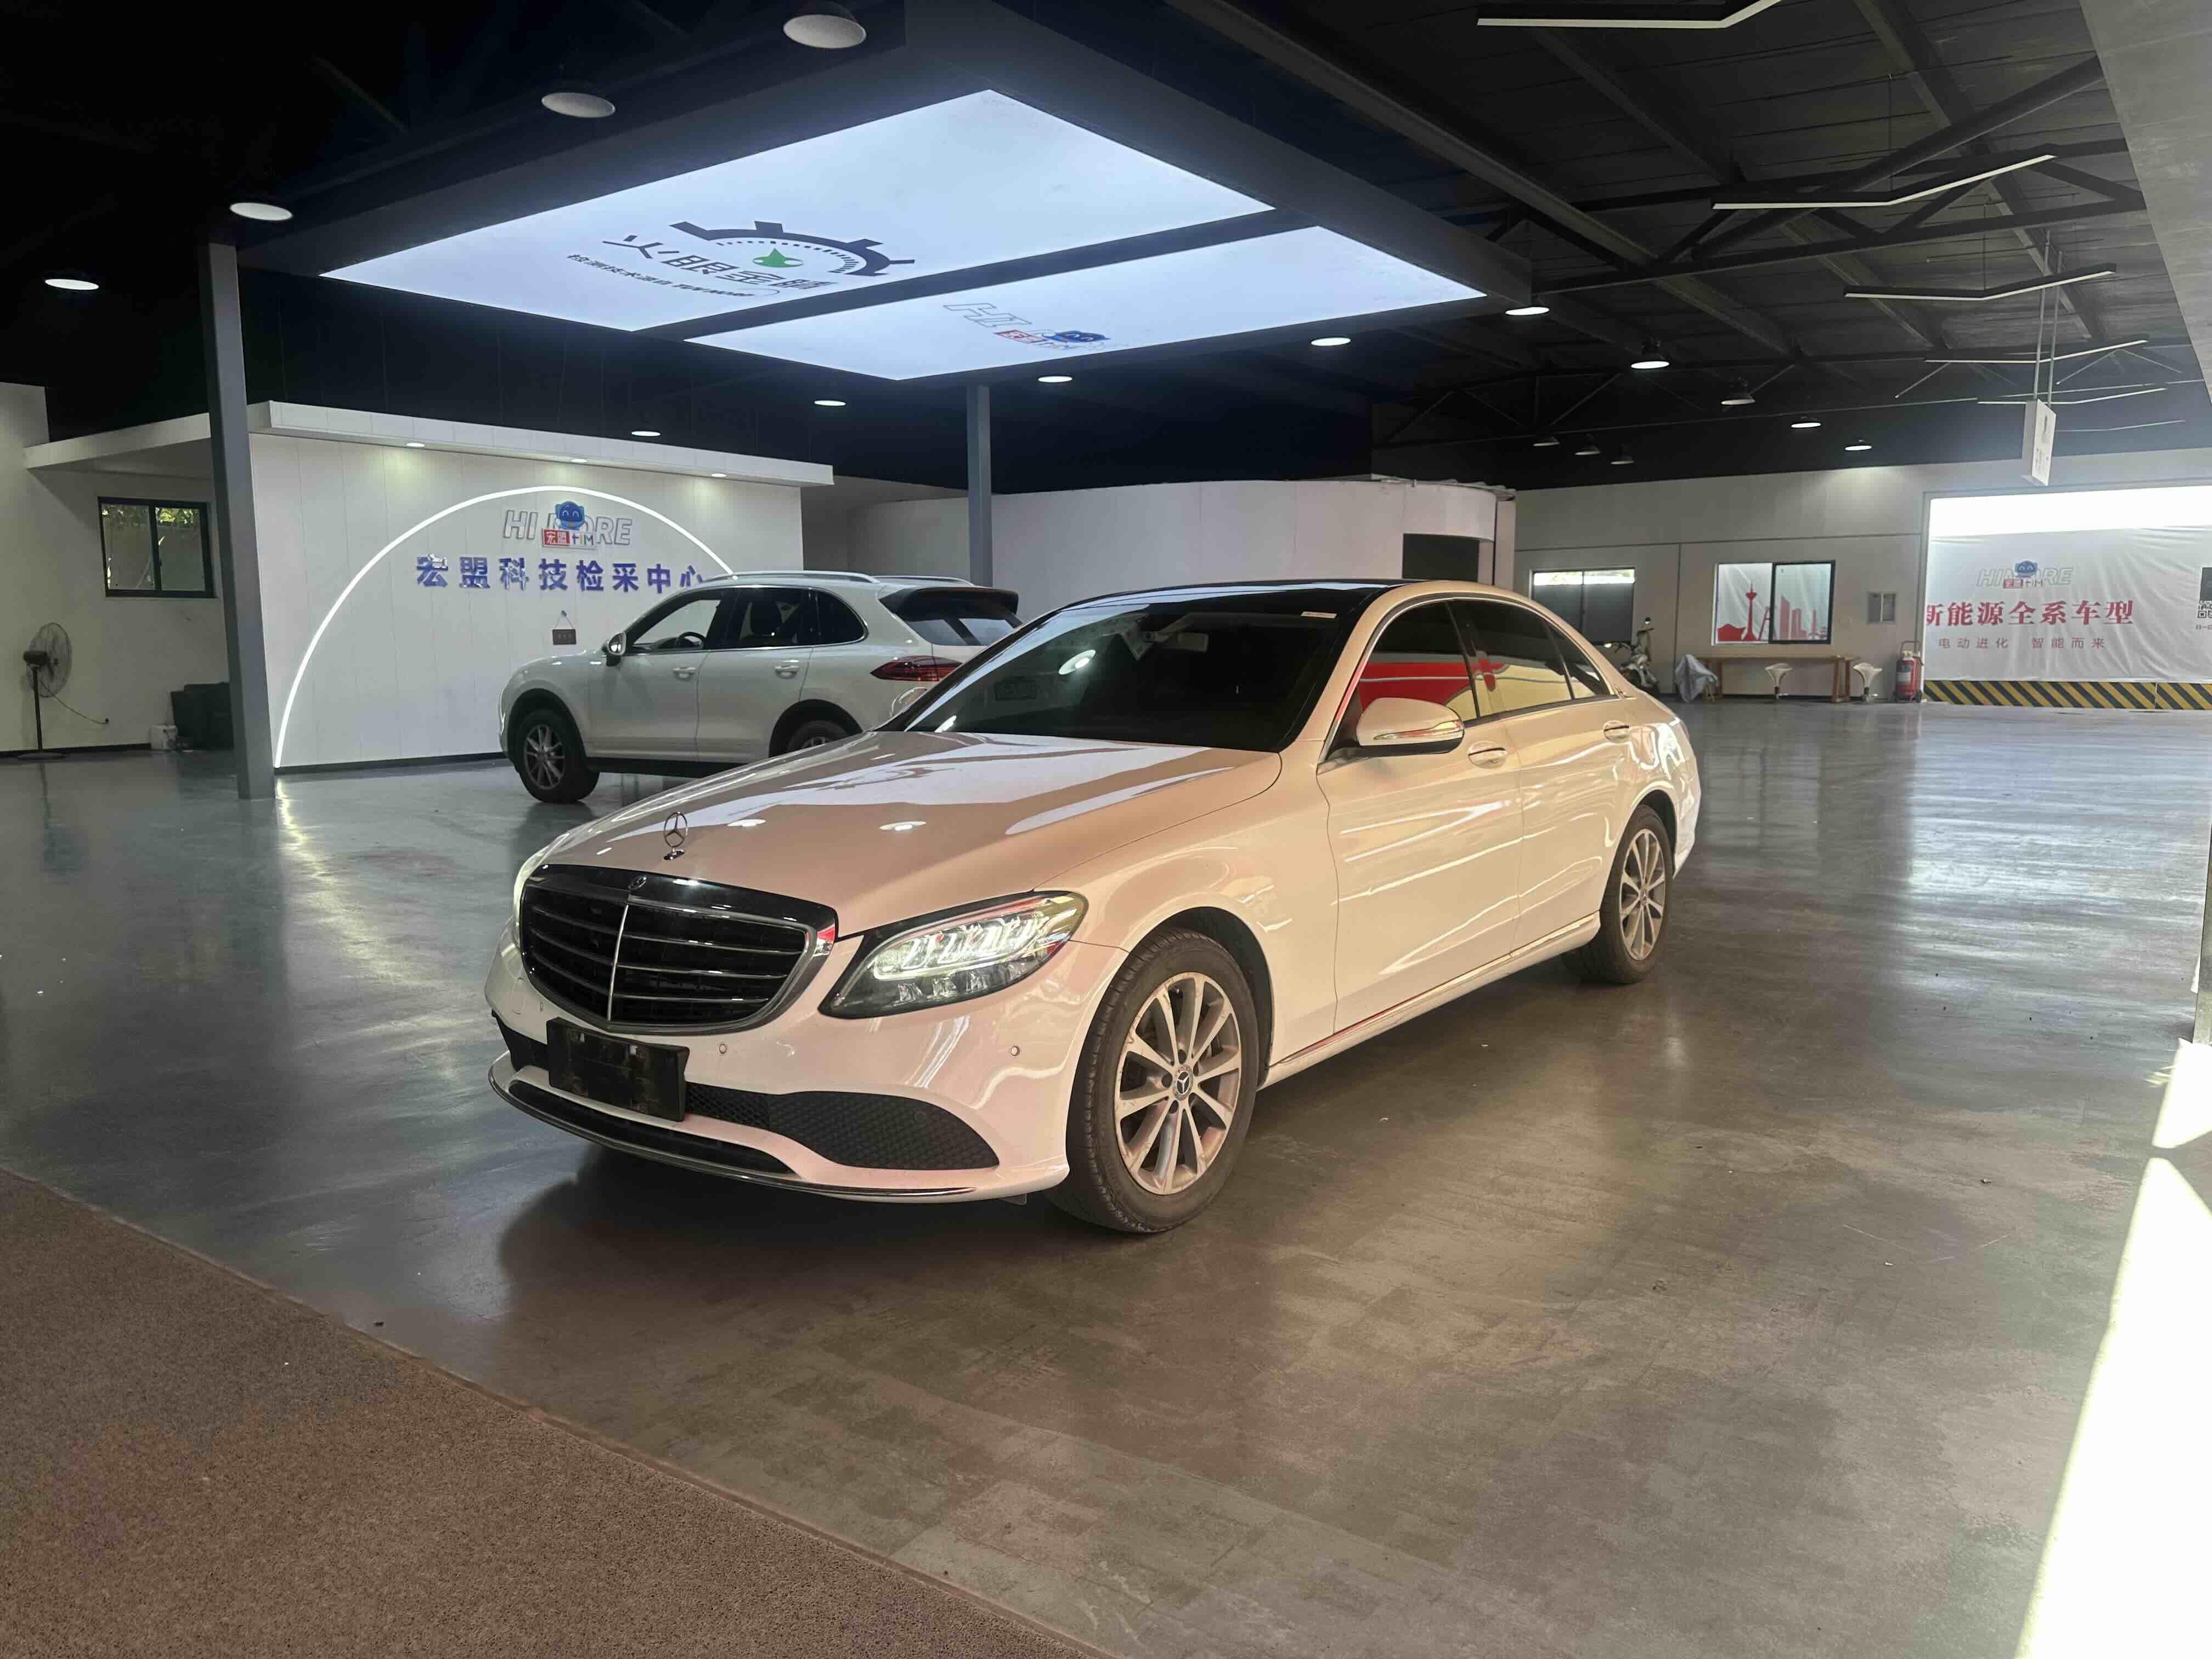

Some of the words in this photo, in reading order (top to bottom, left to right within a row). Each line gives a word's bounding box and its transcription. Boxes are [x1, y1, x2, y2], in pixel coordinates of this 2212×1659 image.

[416, 553, 703, 594] 宏盟科技检采中心
[1926, 600, 2134, 627] 新能源全系车型
[1938, 637, 2010, 650] 电动进化
[2032, 637, 2106, 649] 智能而来
